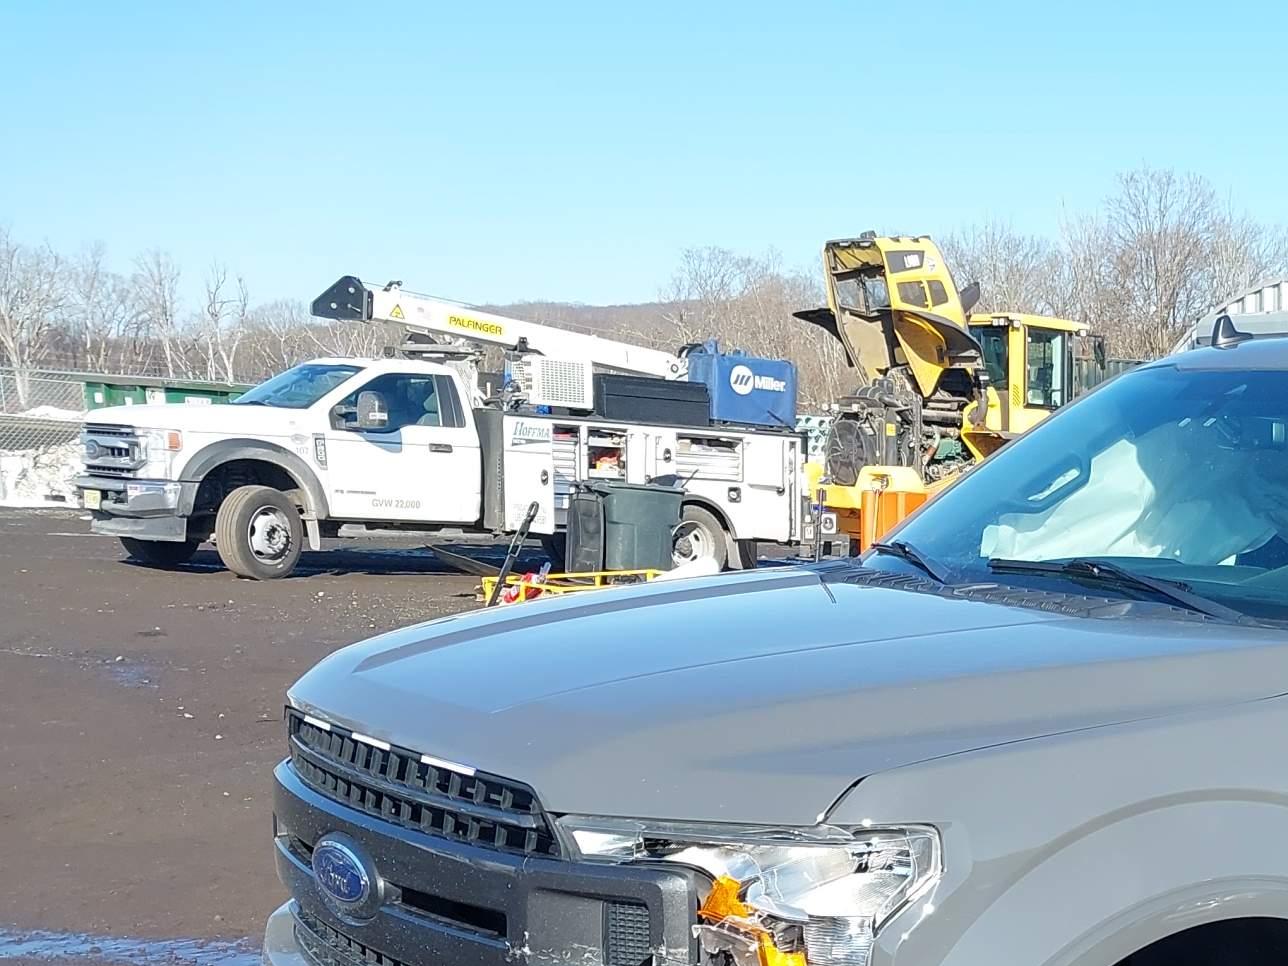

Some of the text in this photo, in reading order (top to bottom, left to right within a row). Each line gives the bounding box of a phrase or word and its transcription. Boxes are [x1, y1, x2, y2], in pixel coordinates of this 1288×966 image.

[449, 316, 502, 335] PALFINGER
[754, 375, 785, 391] Miller
[371, 499, 421, 509] GVW 22,000
